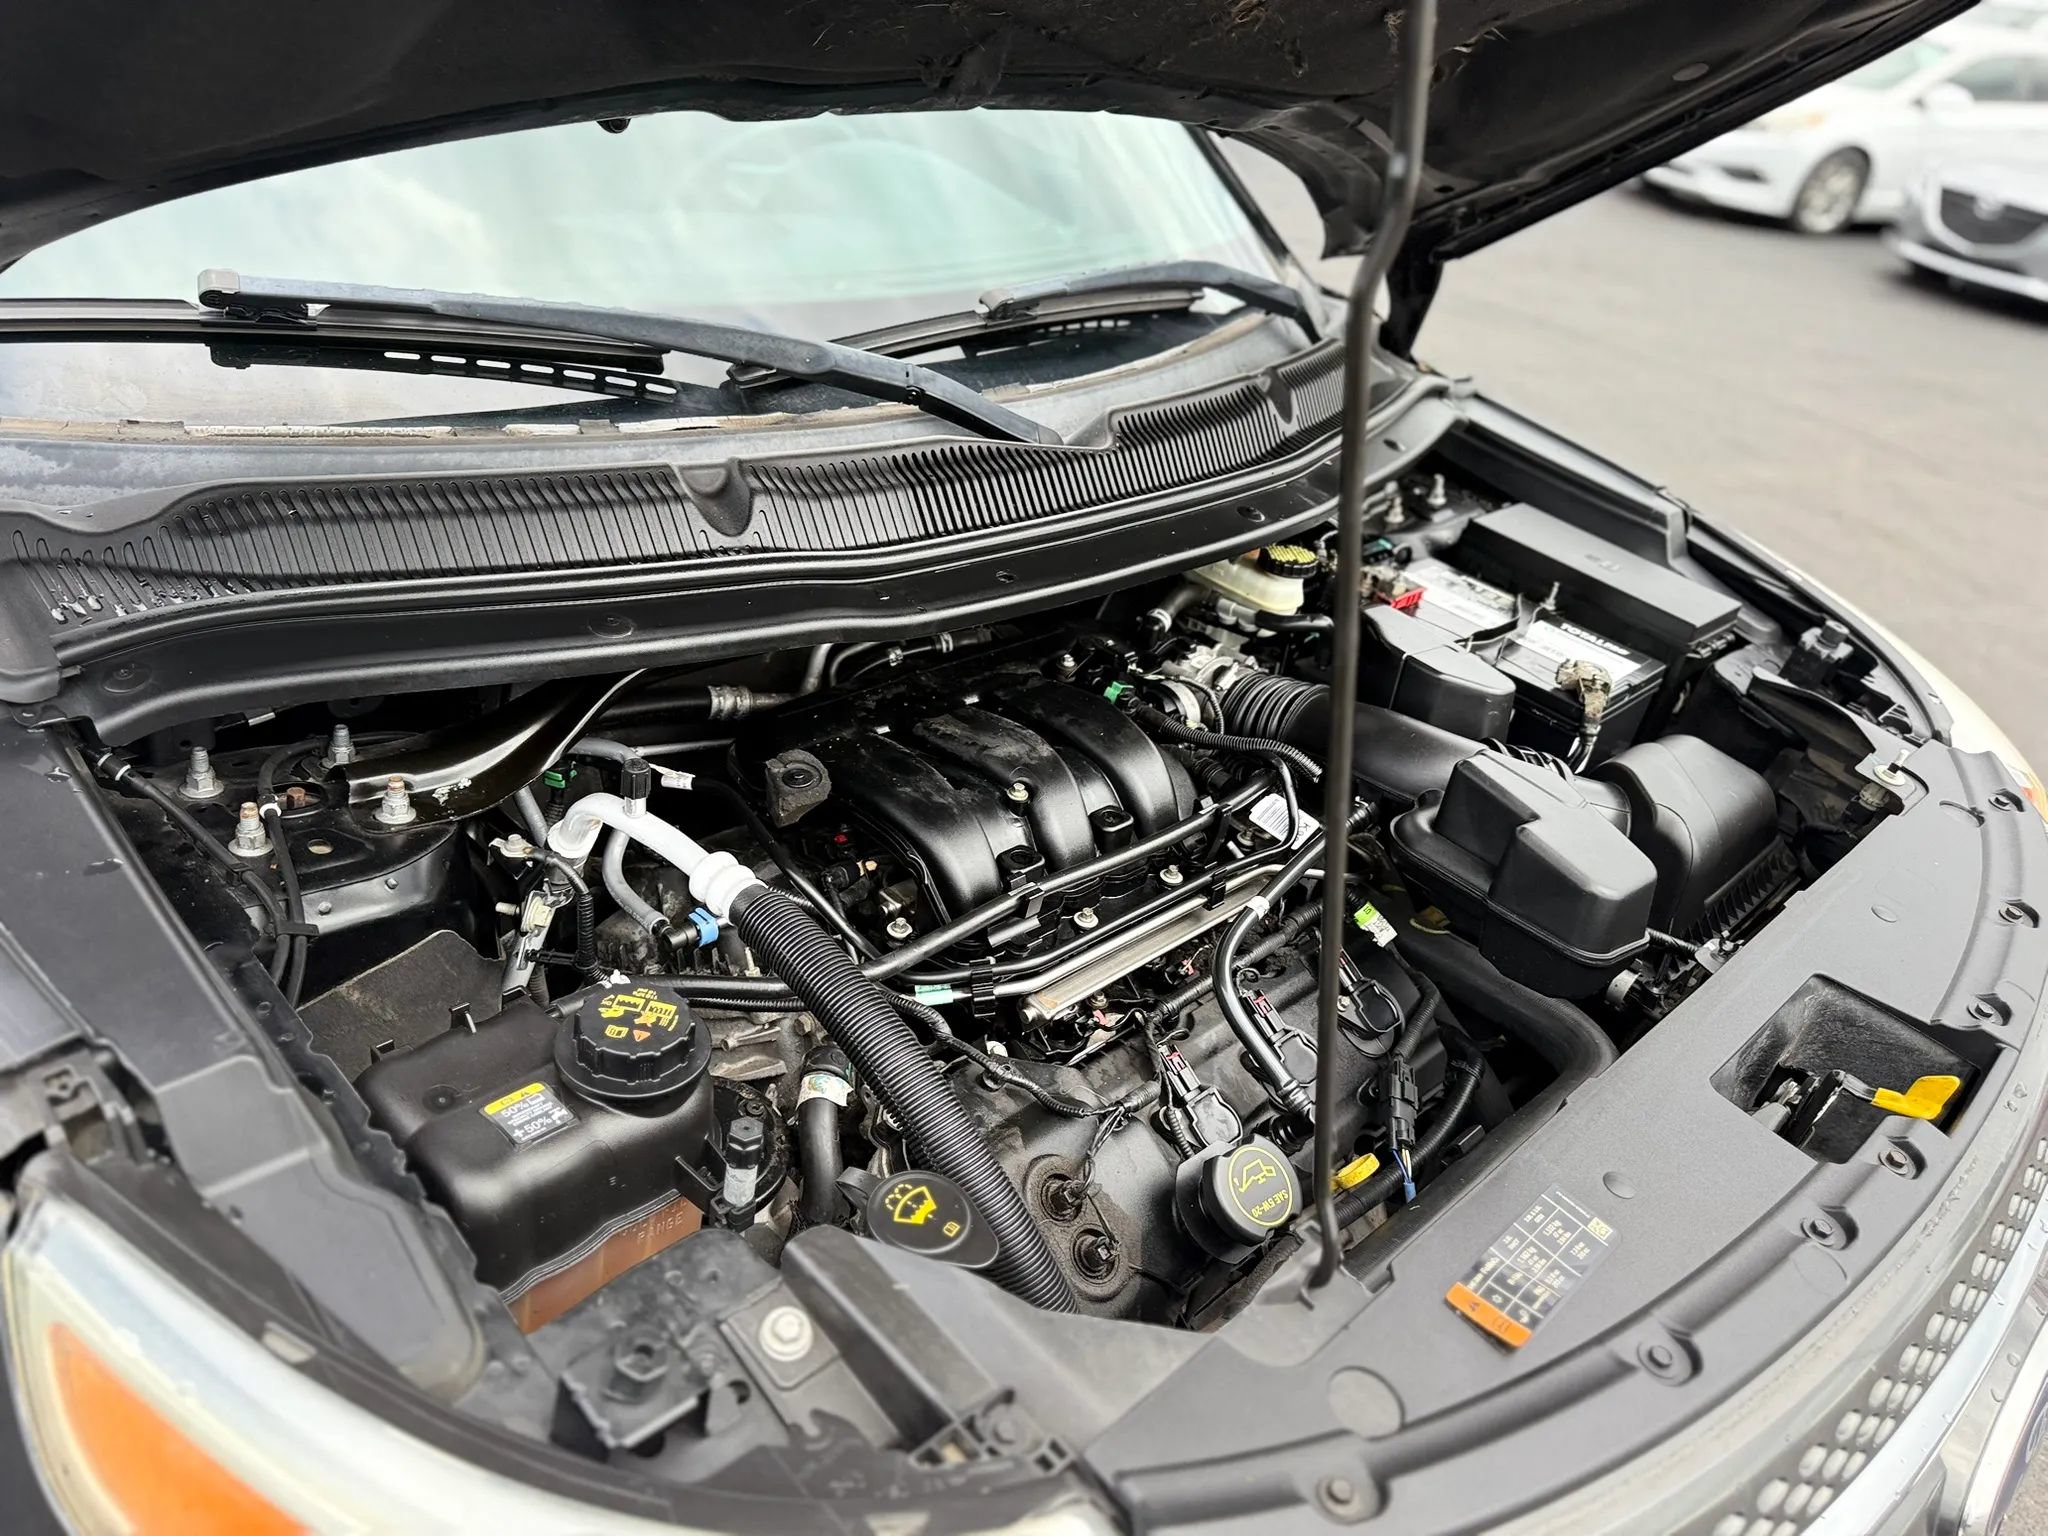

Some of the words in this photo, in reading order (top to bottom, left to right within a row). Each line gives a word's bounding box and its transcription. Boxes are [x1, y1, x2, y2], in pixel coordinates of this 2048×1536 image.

[500, 1102, 530, 1118] 50%
[1272, 1189, 1289, 1204] SAE
[1251, 1197, 1276, 1218] 5W-20
